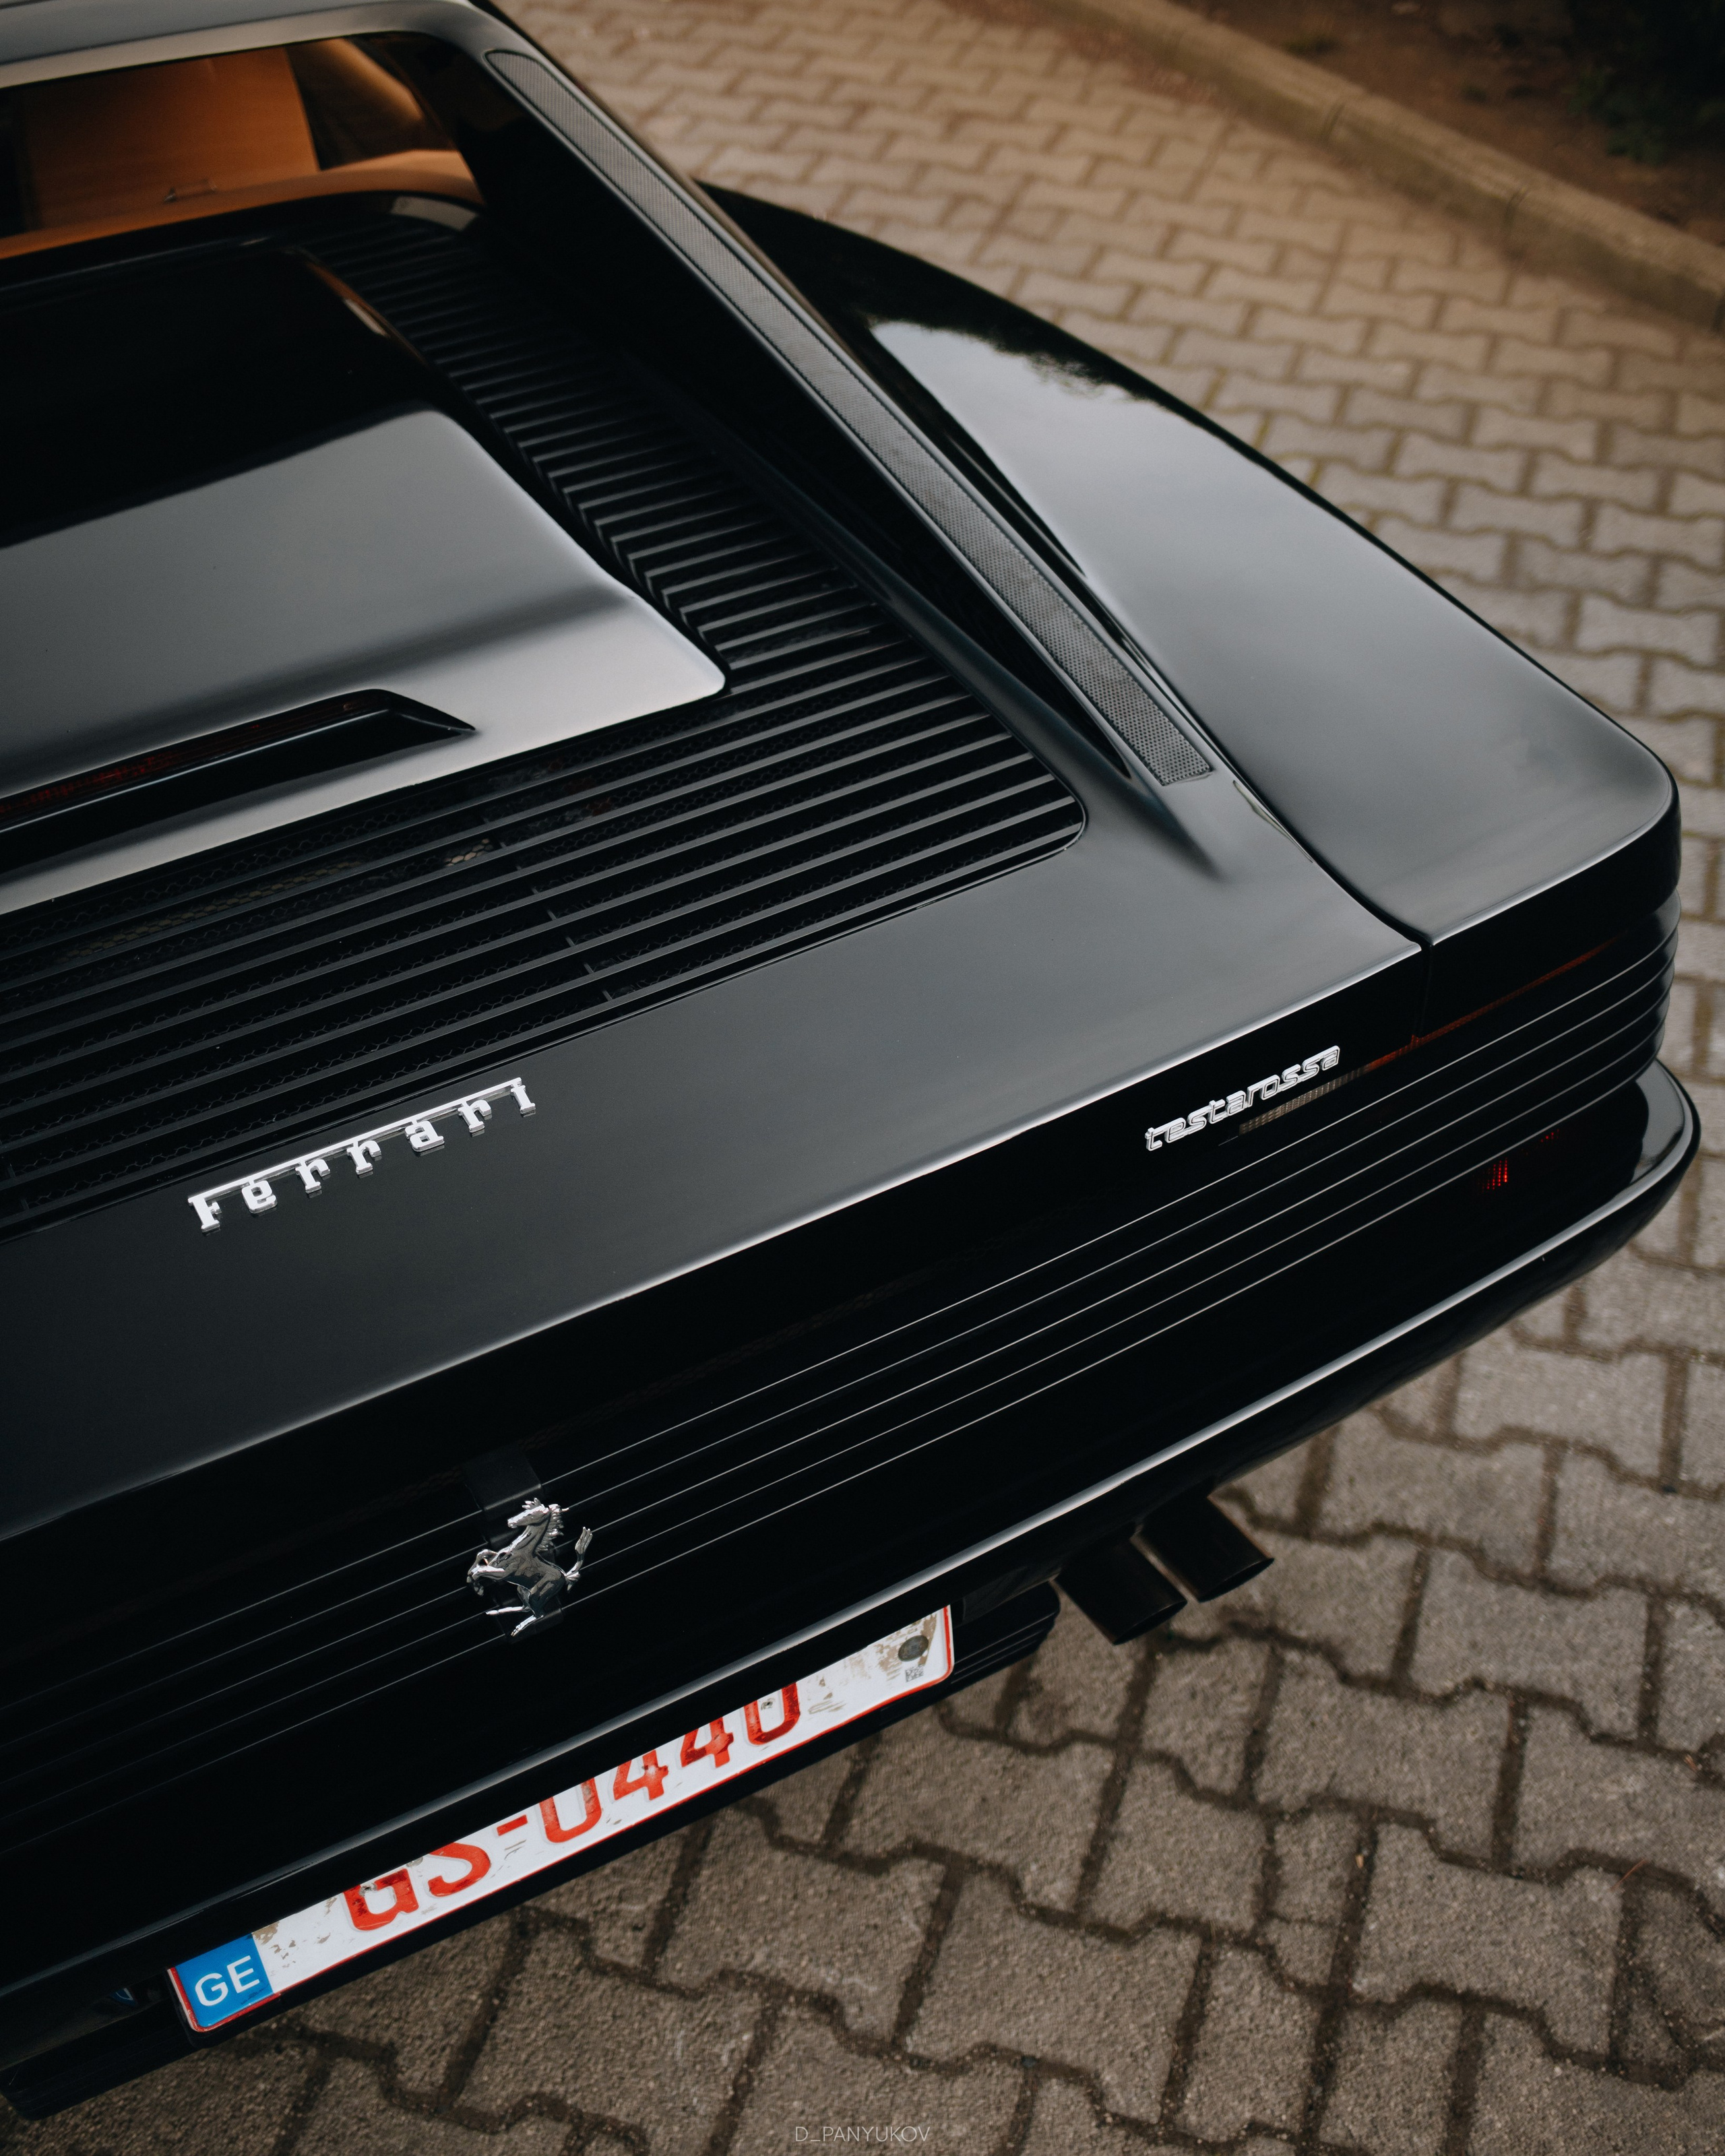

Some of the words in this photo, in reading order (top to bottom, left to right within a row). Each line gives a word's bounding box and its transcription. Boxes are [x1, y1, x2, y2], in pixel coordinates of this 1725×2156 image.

[1145, 1045, 1340, 1151] testarossa
[188, 1077, 536, 1232] Ferrari
[195, 1955, 260, 2007] GE
